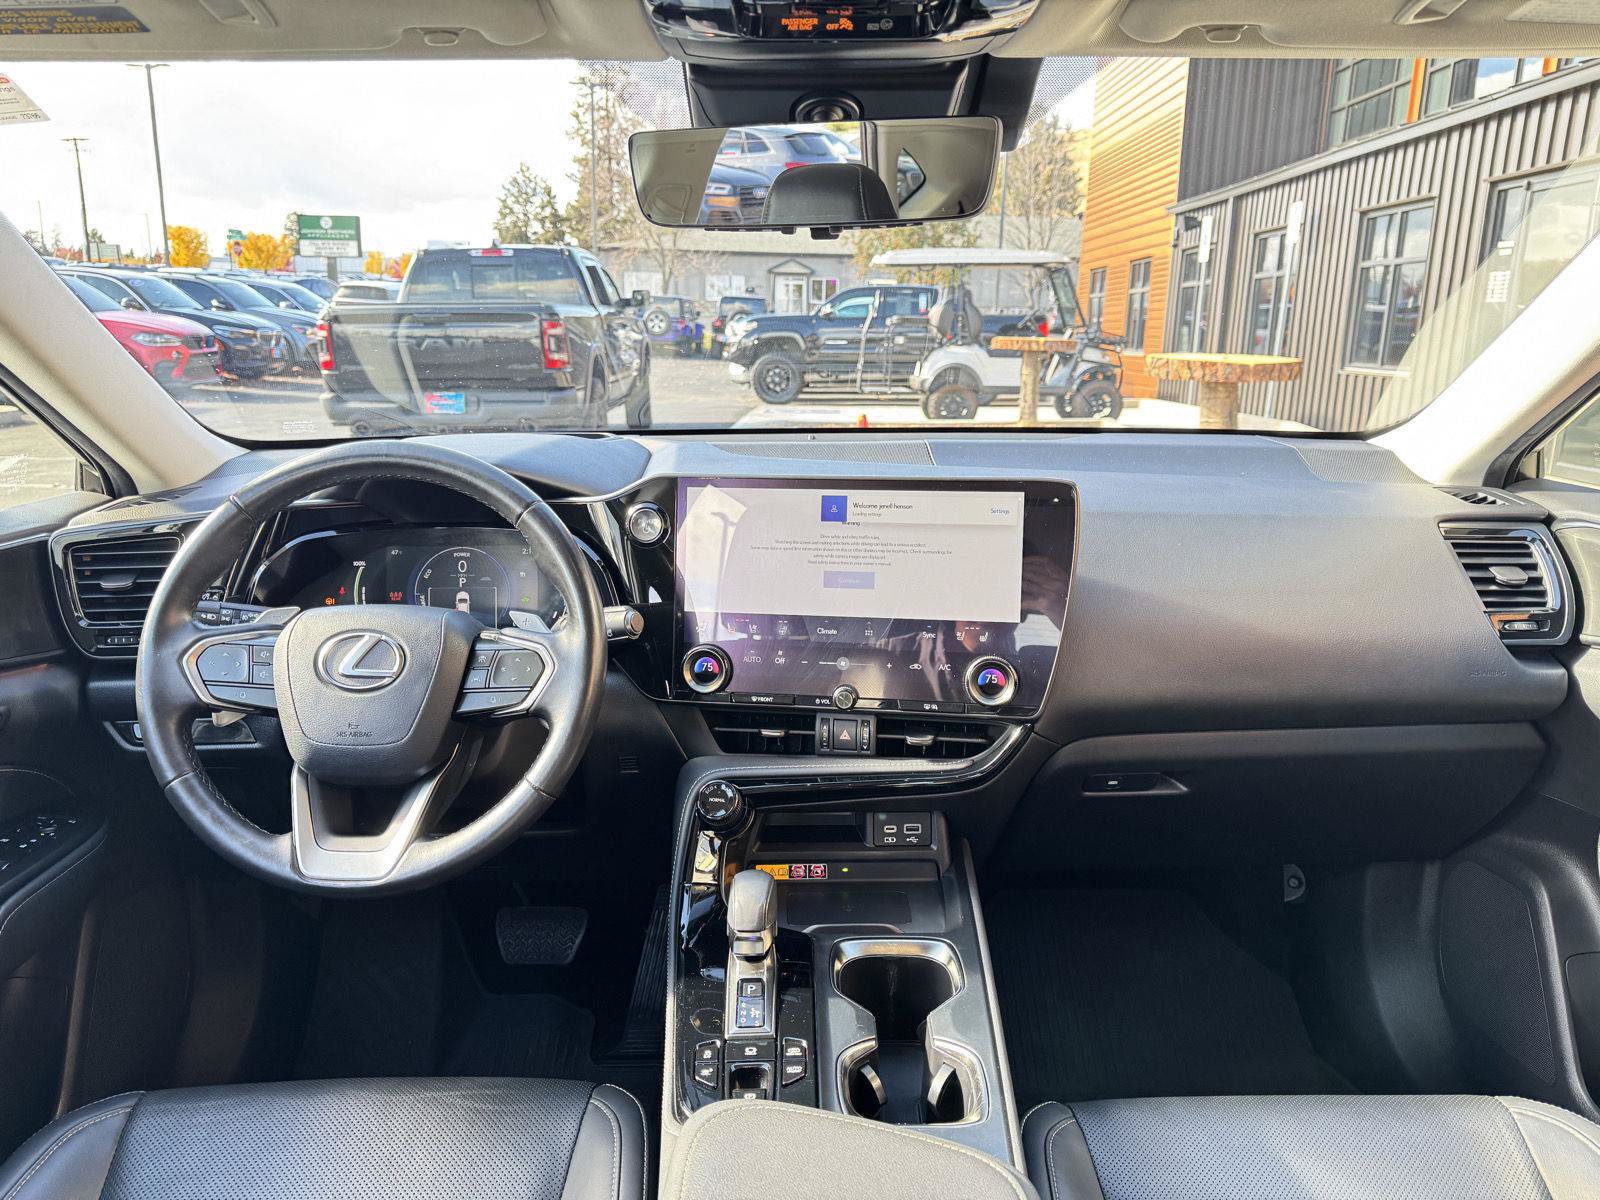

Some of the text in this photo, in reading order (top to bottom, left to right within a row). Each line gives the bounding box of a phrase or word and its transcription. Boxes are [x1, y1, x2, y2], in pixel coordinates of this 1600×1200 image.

[990, 507, 1010, 515] Settings
[458, 560, 467, 573] 0
[459, 577, 467, 588] P
[816, 627, 838, 635] Climate
[922, 631, 936, 639] Sync
[775, 657, 786, 665] Off
[702, 662, 713, 672] 75
[938, 663, 952, 671] A/C
[985, 674, 998, 684] 75
[747, 984, 756, 995] P
